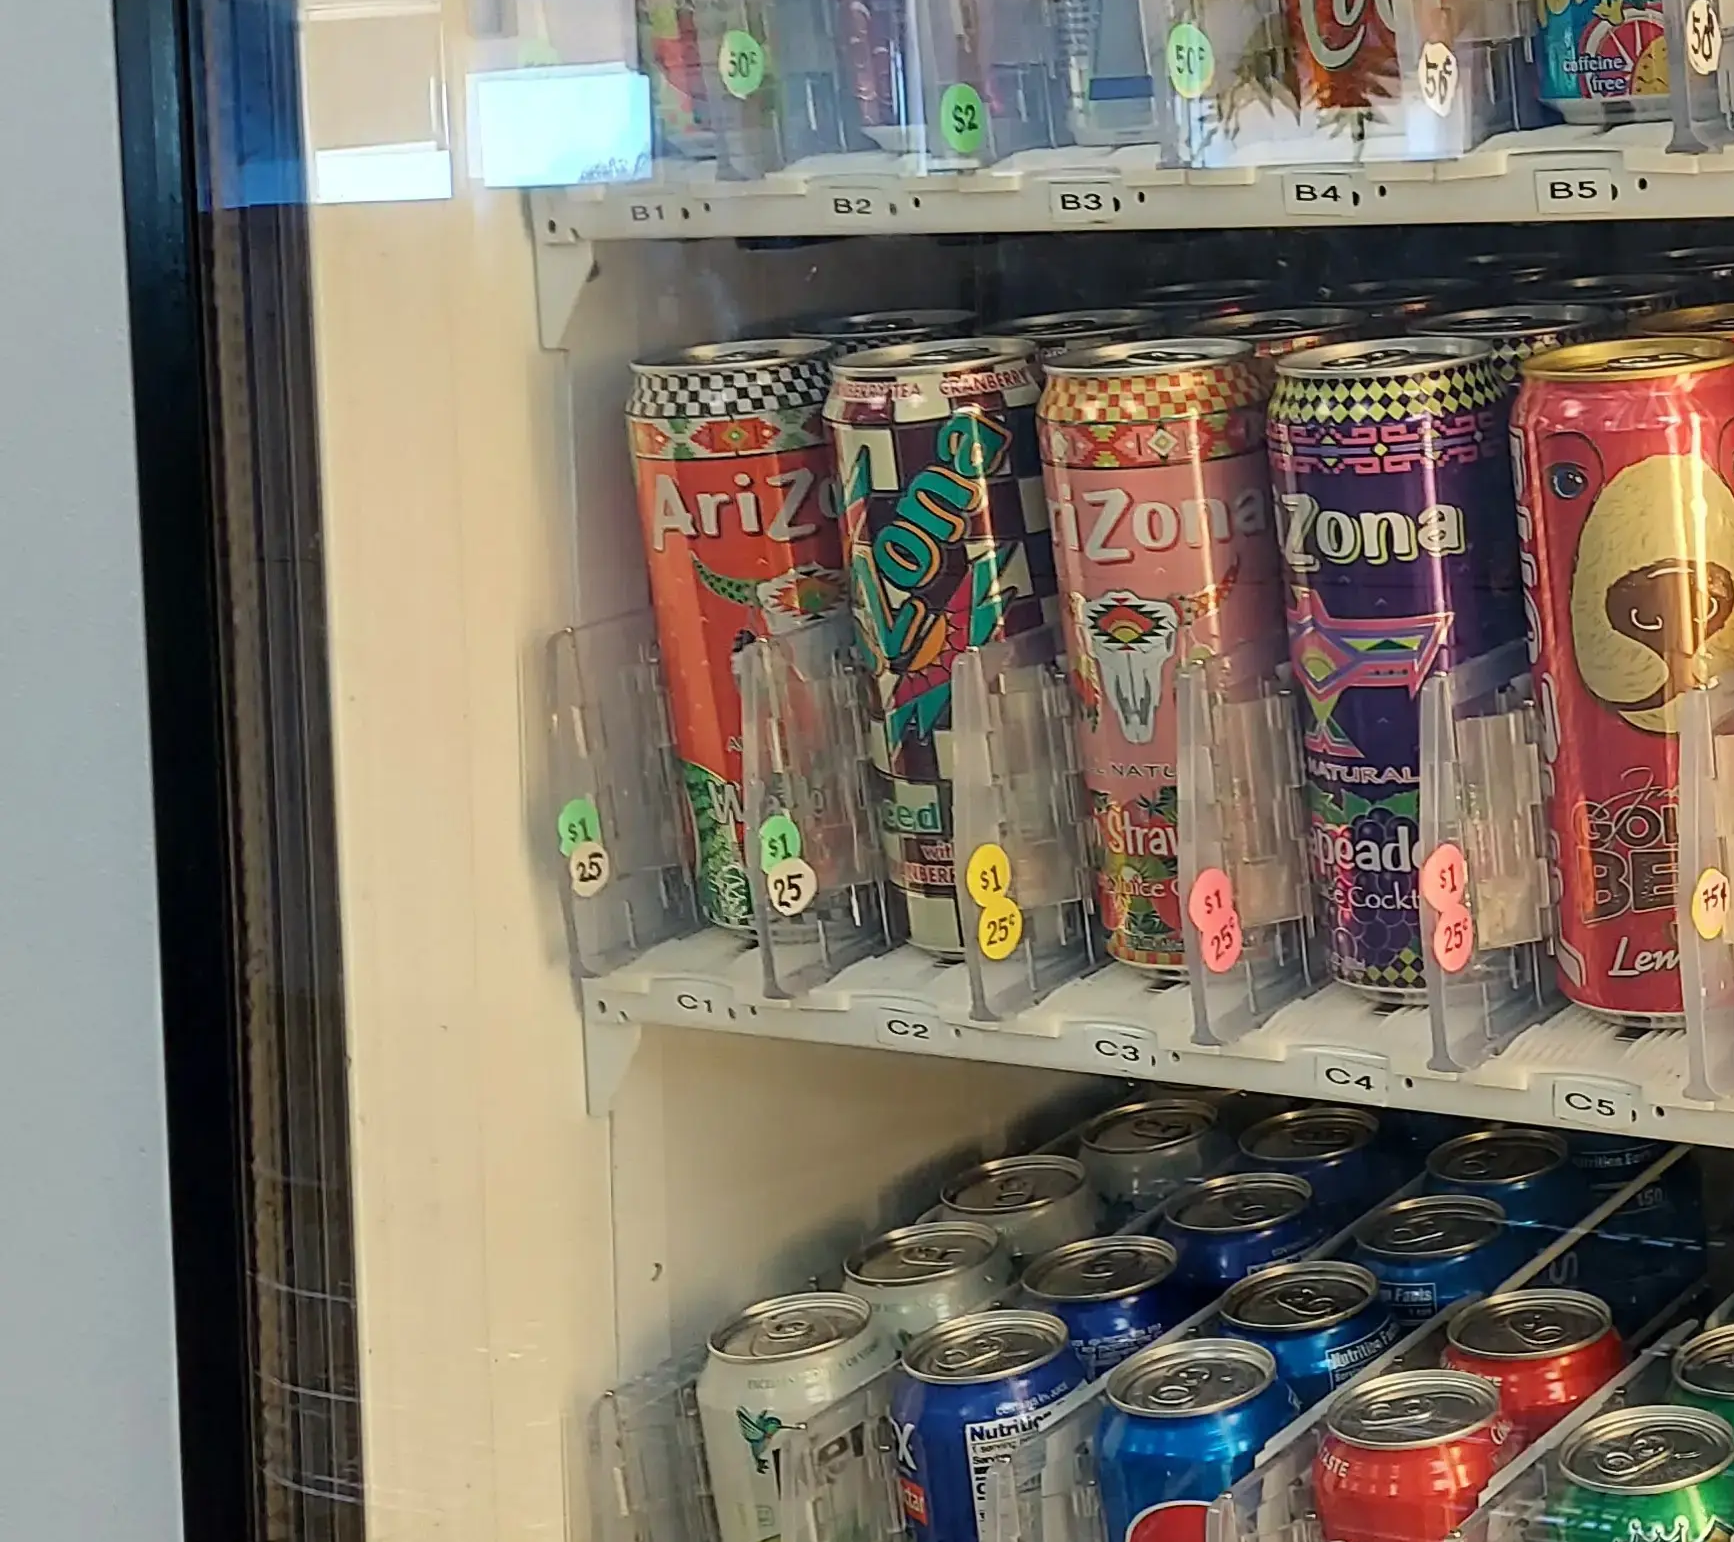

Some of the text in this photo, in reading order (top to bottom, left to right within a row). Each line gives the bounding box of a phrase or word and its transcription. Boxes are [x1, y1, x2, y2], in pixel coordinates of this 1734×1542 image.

[1563, 54, 1623, 72] caffeine
[1590, 74, 1627, 92] free
[1296, 183, 1341, 202] B4
[1550, 180, 1597, 200] B5
[833, 197, 871, 215] B2
[1060, 192, 1102, 210] B3
[631, 204, 665, 220] B1
[768, 832, 791, 858] $1
[978, 864, 1002, 892] $1
[1439, 864, 1458, 895] $1
[774, 873, 803, 908] 25
[678, 993, 713, 1013] C1
[889, 1019, 930, 1040] C2
[1095, 1039, 1139, 1063] C3
[1325, 1067, 1374, 1092] C4
[1565, 1092, 1616, 1118] C5
